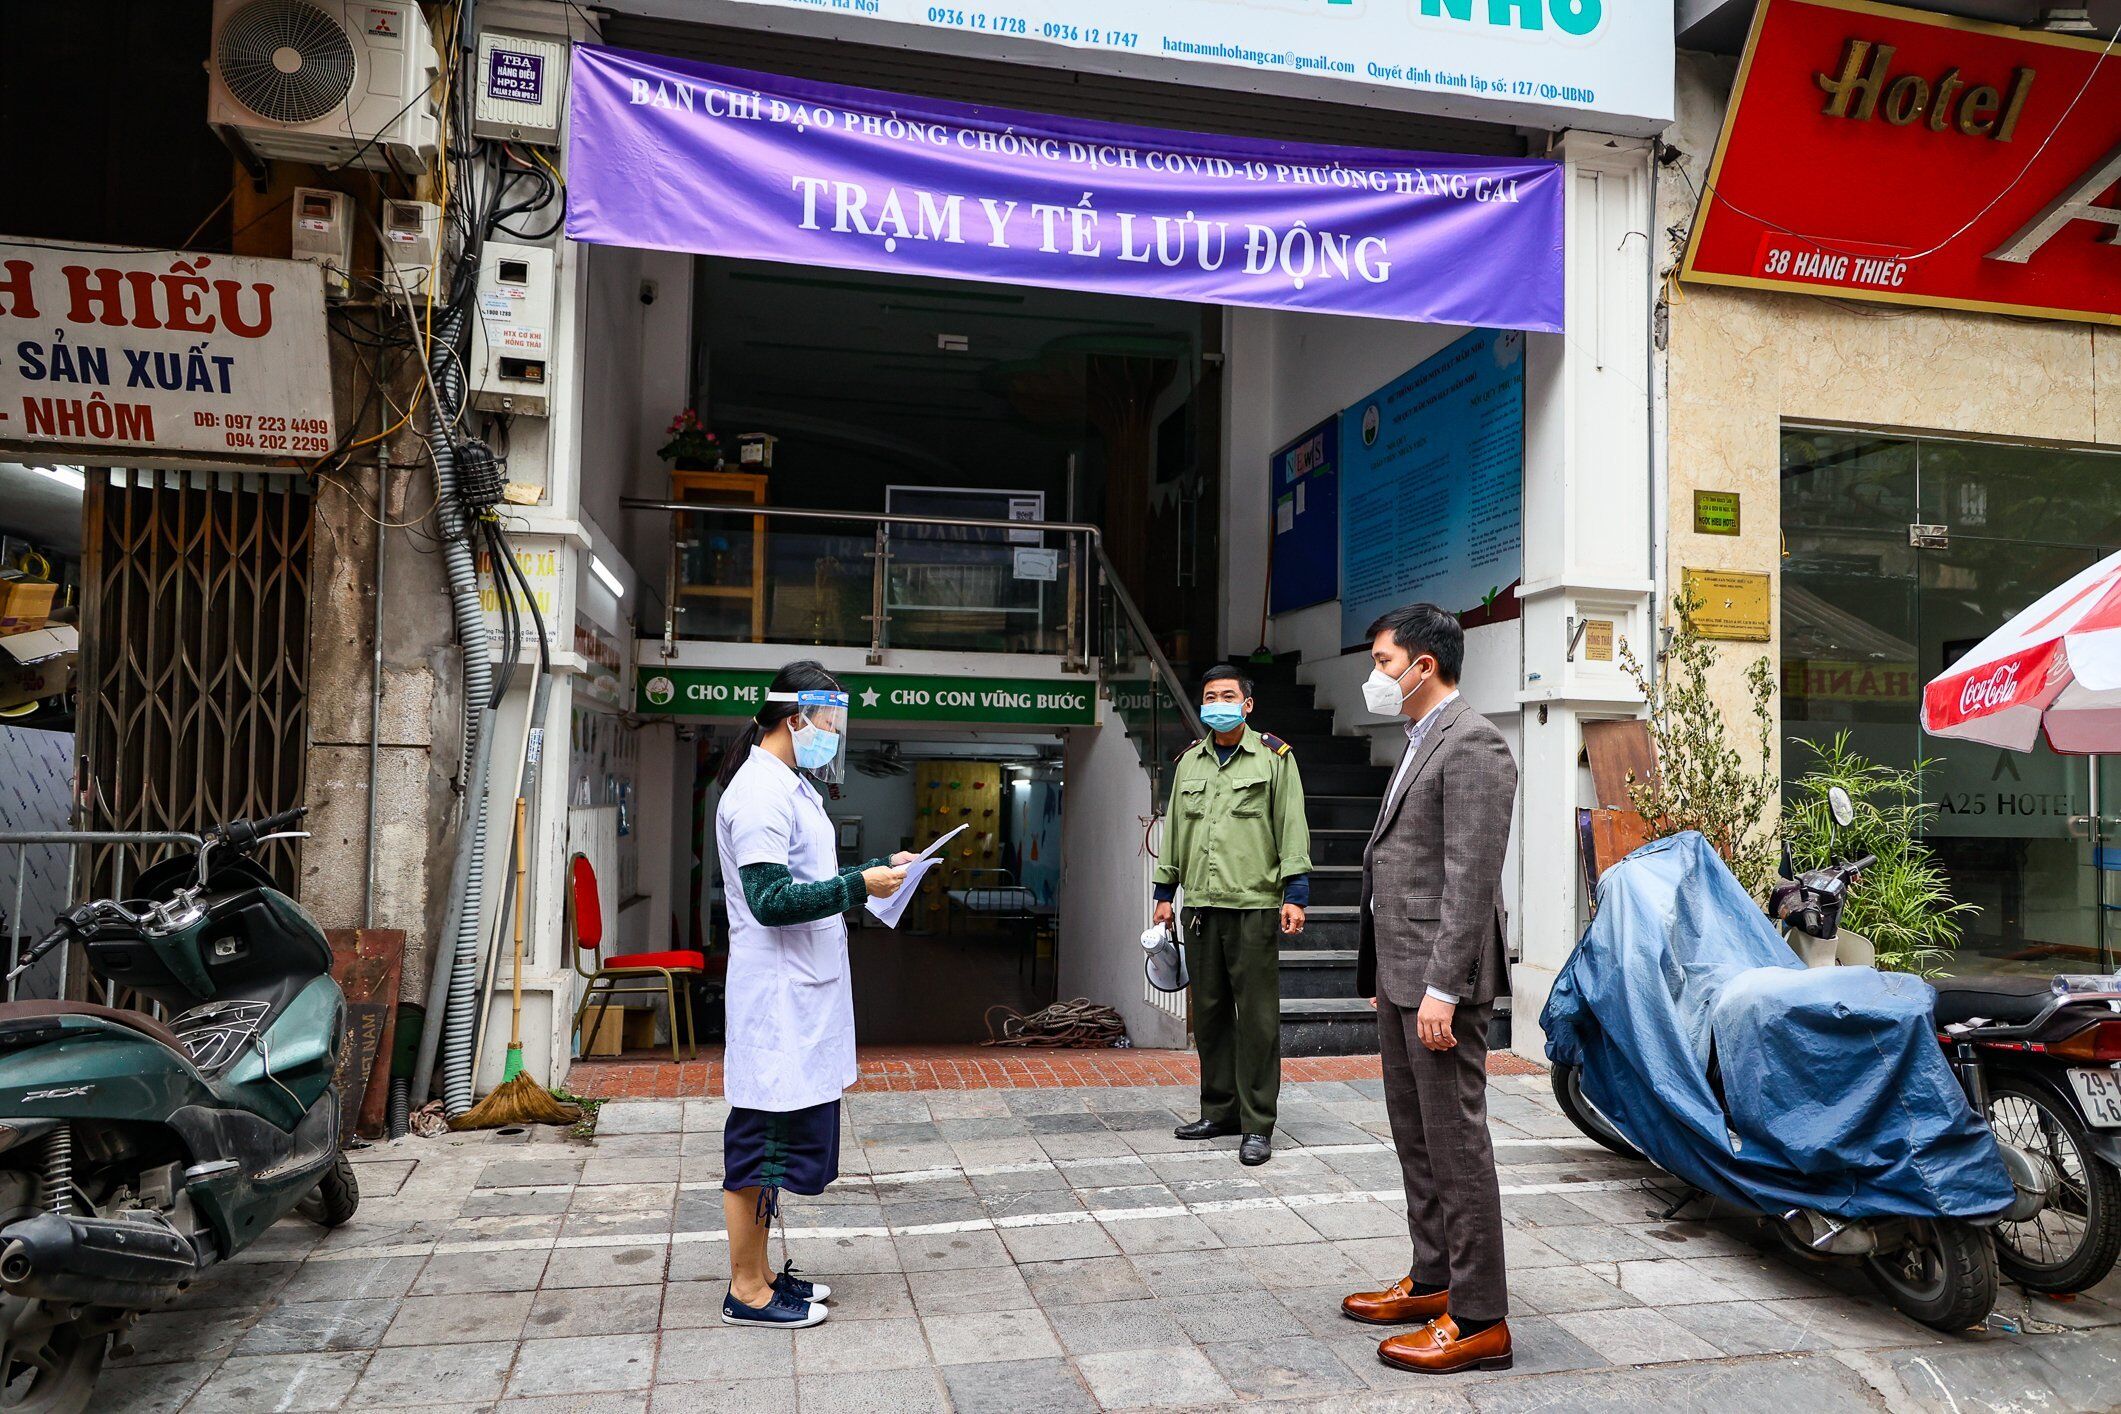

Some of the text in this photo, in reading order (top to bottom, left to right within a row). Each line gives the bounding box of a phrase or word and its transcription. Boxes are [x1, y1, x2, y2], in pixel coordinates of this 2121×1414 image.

[928, 7, 964, 26] 0936
[971, 14, 986, 29] 12
[992, 16, 1027, 34] 1728
[1044, 22, 1078, 41] 0936
[1084, 28, 1101, 44] 12
[1105, 30, 1138, 48] 1747
[502, 55, 532, 68] TBA
[1162, 36, 1356, 75] hatmamnhohangcan@gmail.com
[497, 77, 535, 91] HPD 2.2
[1367, 61, 1595, 104] Quyết định thành lập số: 127/QĐ-UBND
[1819, 39, 2037, 143] Hotel
[629, 77, 1520, 204] BAN CHỈ ĐẠO PHÒNG CHỐNG DỊCH COVID-19 PHƯỜNG HÀNG GAI
[790, 174, 1393, 291] TRẠM Y TẾ LƯU ĐỘNG
[1764, 246, 1907, 288] 38 HÀNG THIẾC
[61, 256, 275, 339] HIẾU
[17, 328, 235, 395] SẢN XUẤT
[22, 391, 156, 442] NHÔM
[224, 414, 252, 430] 097
[258, 416, 287, 432] 223
[290, 417, 328, 434] 4499
[225, 432, 329, 452] 094 202 2299
[686, 684, 759, 704] CHO MẸ
[890, 689, 1086, 710] CHO CON VỮNG BƯỚC
[1938, 791, 2080, 816] A25 HOTEL
